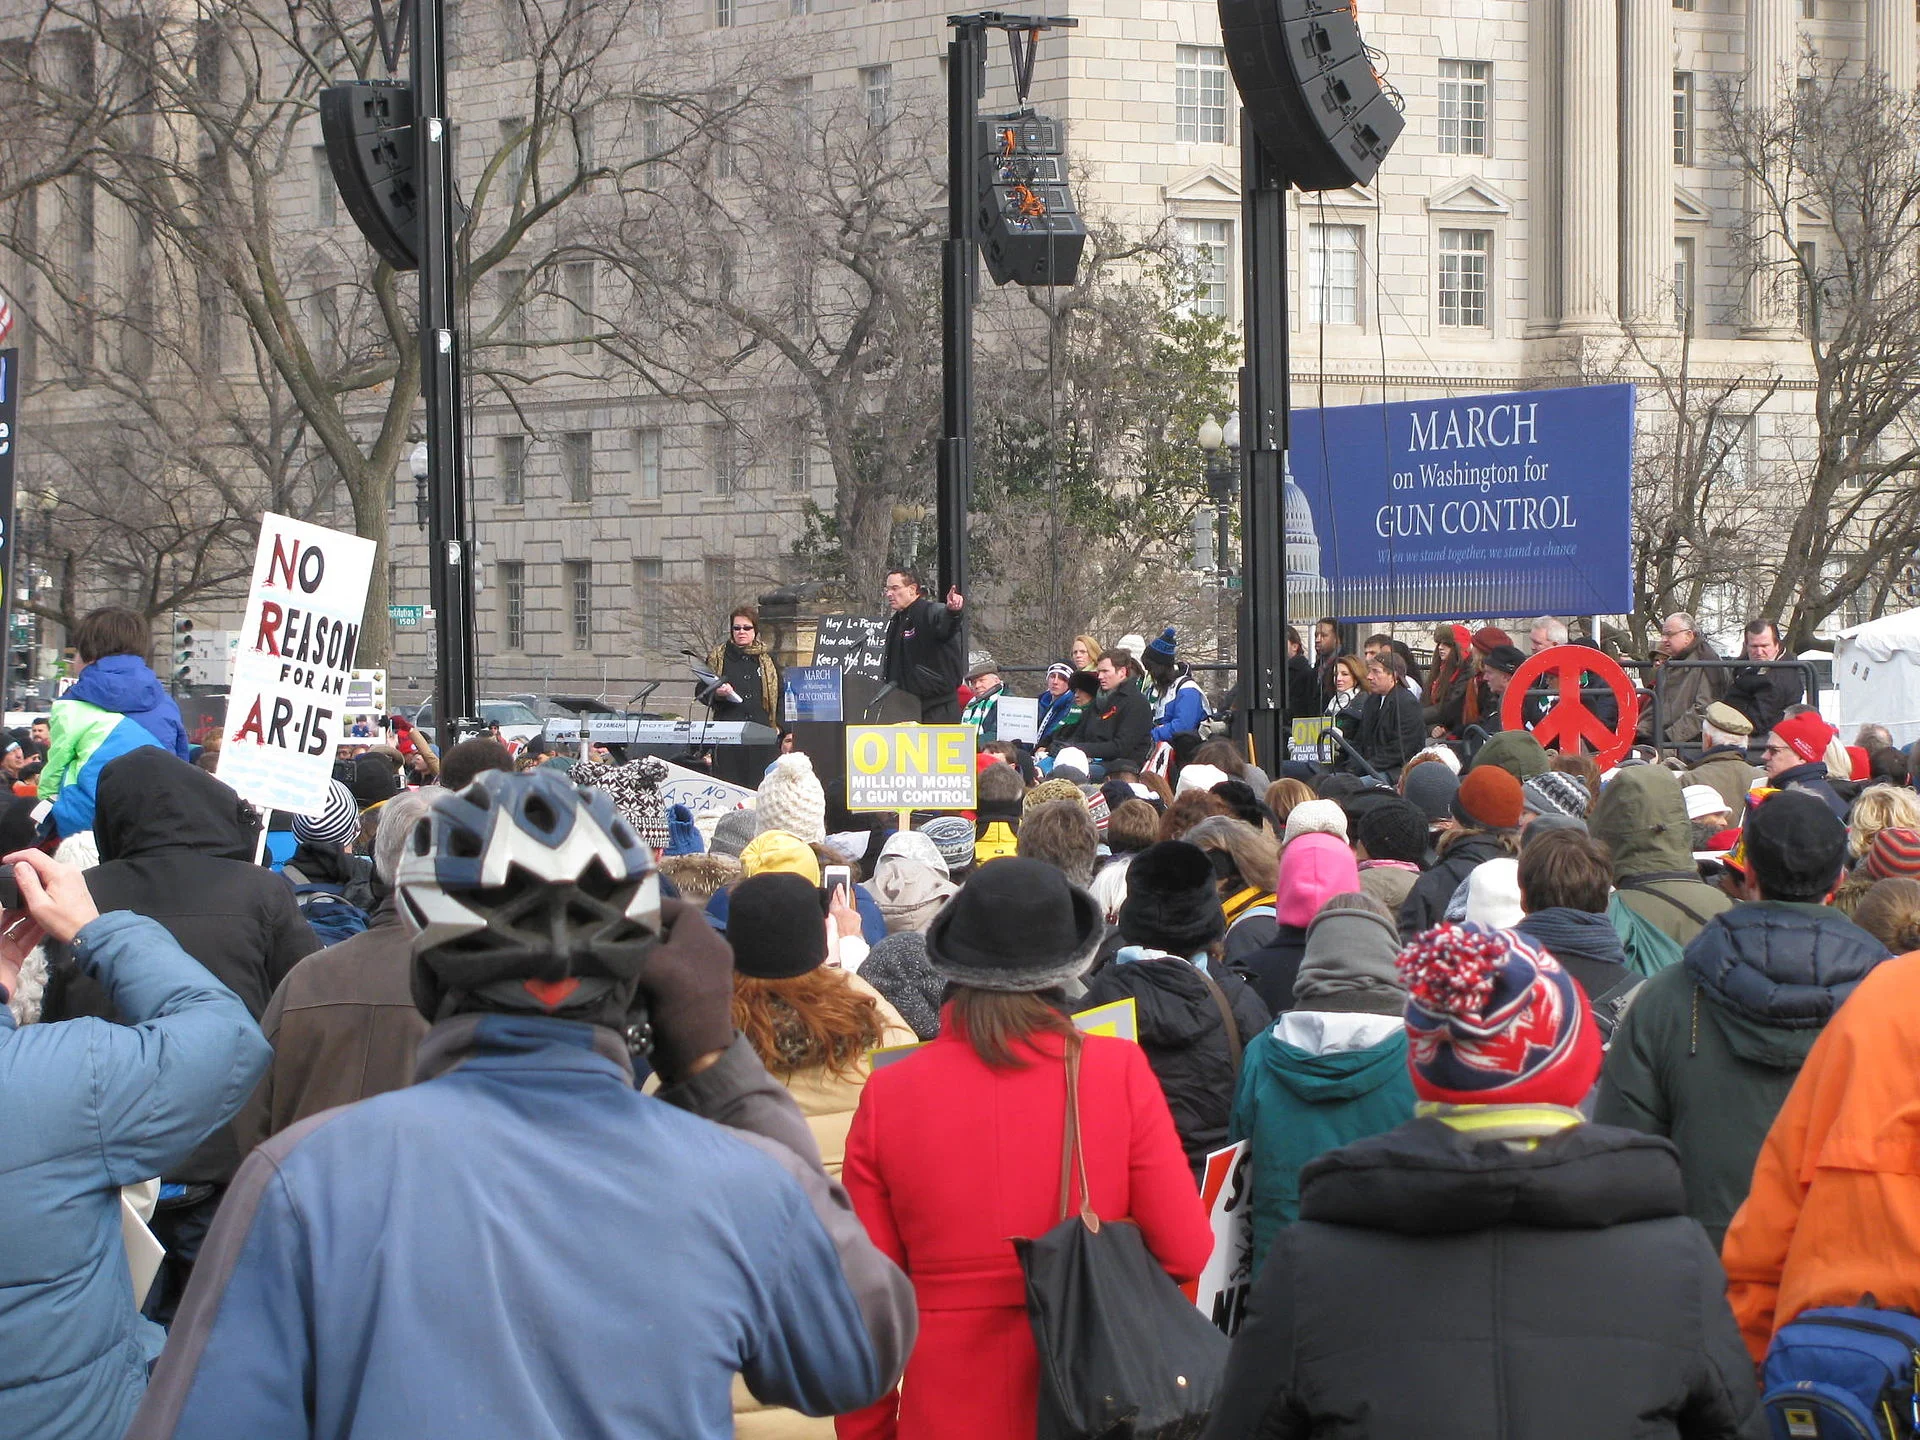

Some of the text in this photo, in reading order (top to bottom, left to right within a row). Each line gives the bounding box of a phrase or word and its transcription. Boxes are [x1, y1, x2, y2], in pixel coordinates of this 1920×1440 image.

[1408, 403, 1538, 452] MARCH
[1393, 455, 1549, 493] on Washington for
[1375, 495, 1577, 537] GUN CONTROL
[1406, 551, 1418, 562] we
[1420, 545, 1446, 562] stand
[1448, 544, 1487, 565] together,
[1490, 548, 1502, 559] we
[1504, 541, 1532, 559] stand
[1534, 546, 1541, 557] a
[1543, 540, 1578, 556] chance
[261, 533, 325, 594] NO
[389, 607, 414, 618] stitution
[826, 618, 842, 633] Hey
[255, 600, 358, 673] REASON
[819, 634, 836, 646] How
[866, 635, 886, 647] this
[816, 653, 839, 667] Keep
[863, 653, 882, 667] Bad
[280, 663, 314, 689] FOR
[321, 675, 344, 696] AN
[804, 669, 831, 680] MARCH
[798, 691, 837, 701] GUN CONTROL
[852, 731, 967, 775] ONE
[852, 775, 972, 789] MILLION MOMS
[664, 788, 717, 811] ASSA
[702, 786, 727, 800] NO
[852, 790, 972, 803] 4 GUN CONTROL
